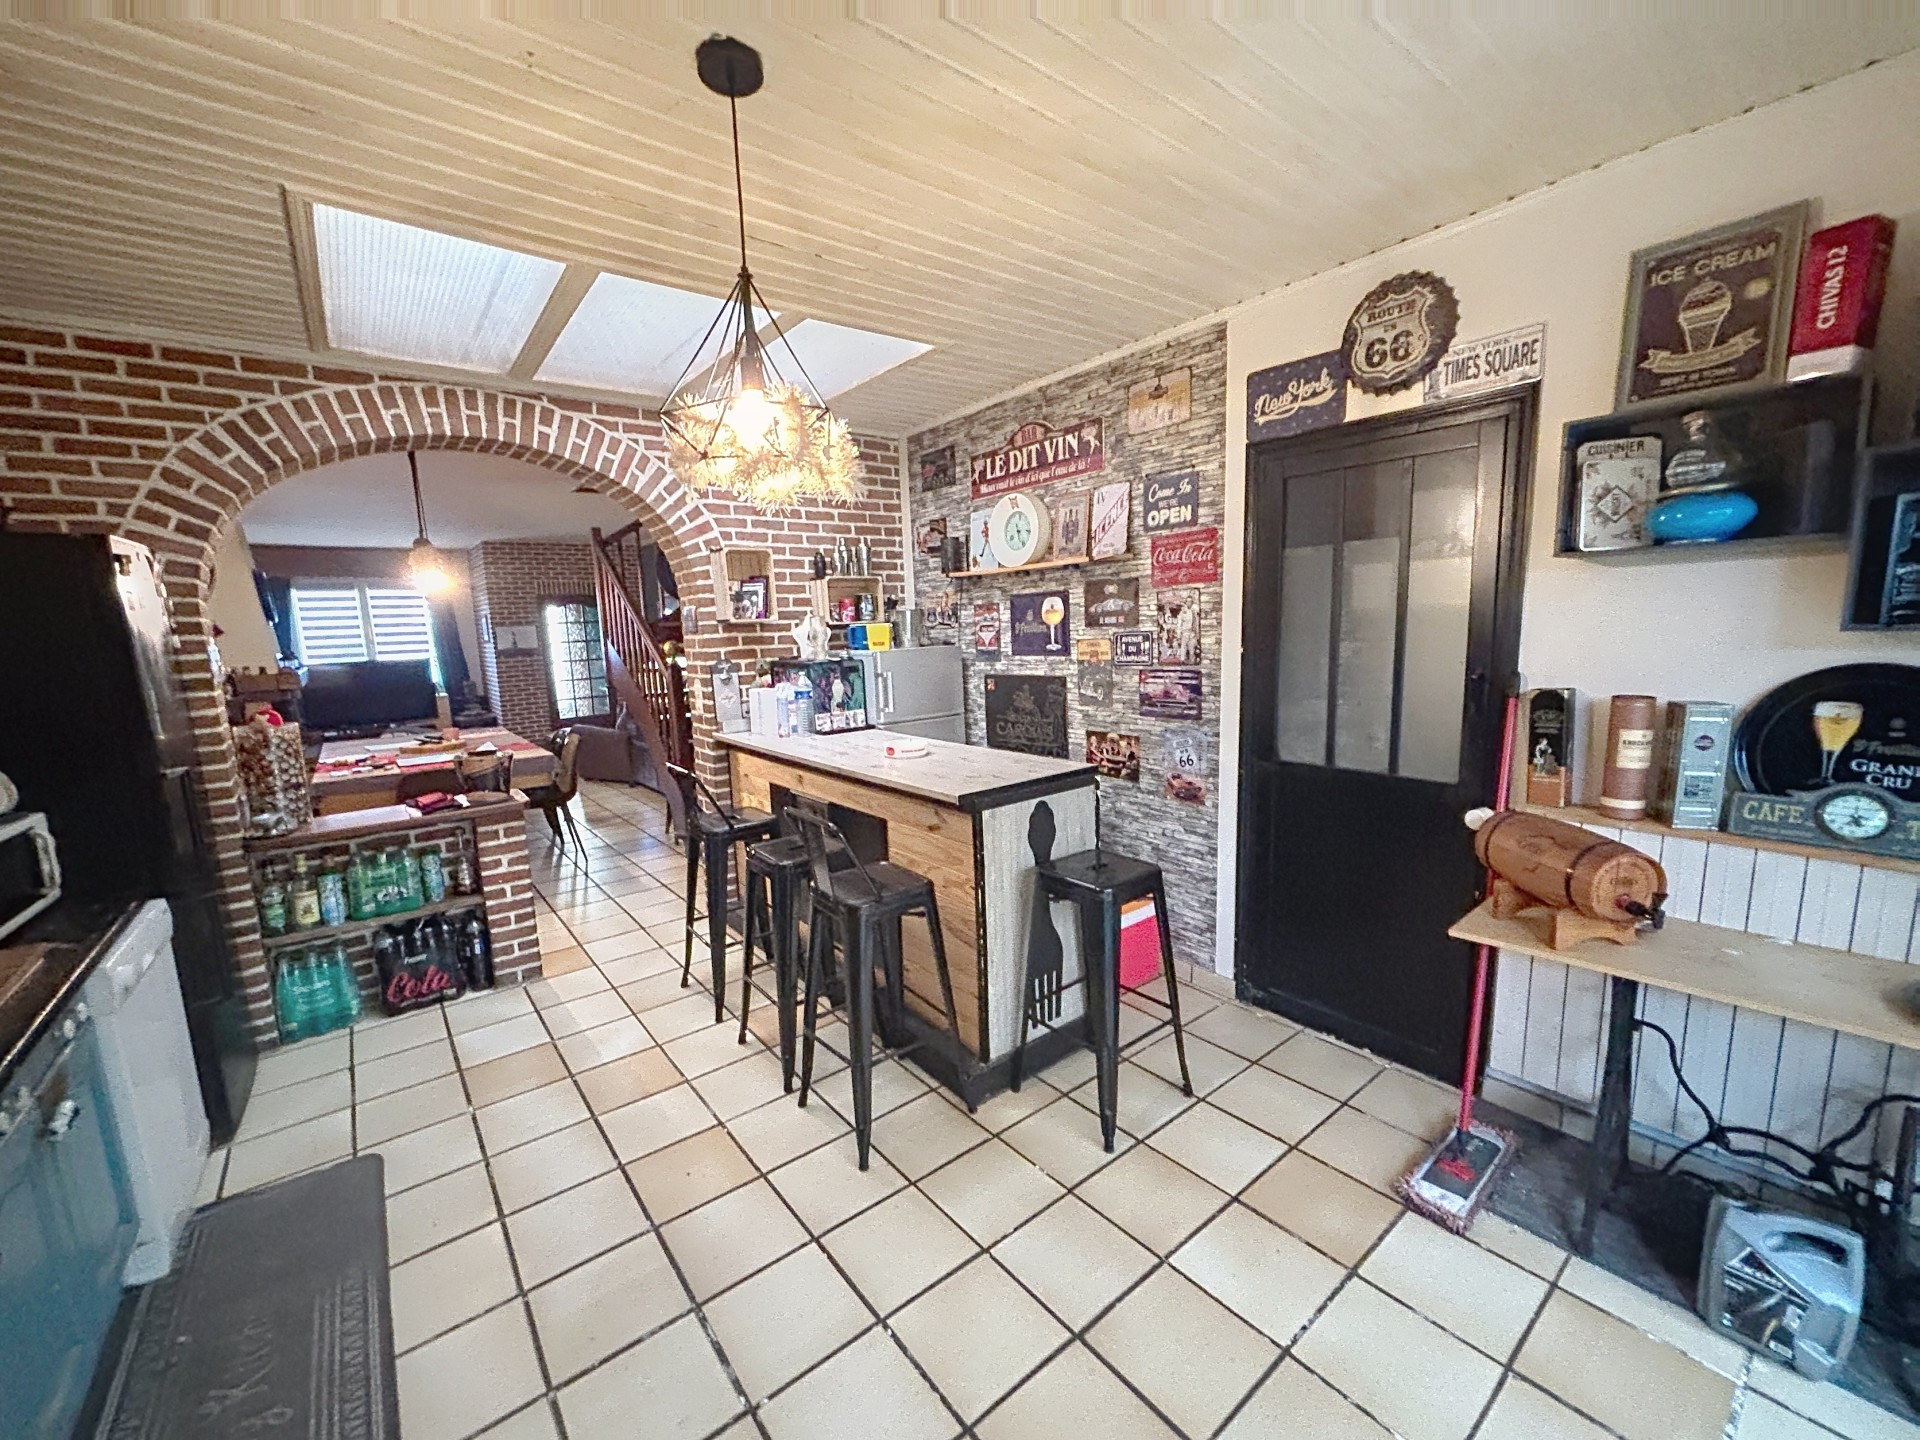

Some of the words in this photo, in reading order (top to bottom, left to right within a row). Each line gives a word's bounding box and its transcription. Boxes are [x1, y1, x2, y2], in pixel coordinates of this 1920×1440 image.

[1649, 265, 1687, 287] ICE
[1694, 242, 1777, 275] CREAM
[1827, 245, 1849, 265] 12
[1816, 265, 1845, 330] CHIVAS
[1367, 299, 1417, 322] ROUTE
[1365, 330, 1414, 368] 66
[1443, 353, 1481, 386] TIMES
[1484, 338, 1540, 376] SQUARE
[1254, 392, 1293, 417] New
[1288, 367, 1334, 404] York
[986, 454, 1007, 479] LE
[1009, 443, 1041, 473] DIT
[1044, 431, 1080, 463] VIN
[1588, 440, 1645, 456] CUISINIER
[1148, 483, 1175, 502] Come
[1177, 477, 1192, 495] In
[1147, 504, 1192, 527] OPEN
[1121, 635, 1143, 643] AVENUE
[1179, 753, 1194, 768] 66
[1865, 773, 1912, 789] CRU
[1742, 801, 1805, 824] CAFE
[387, 964, 450, 1003] Cola
